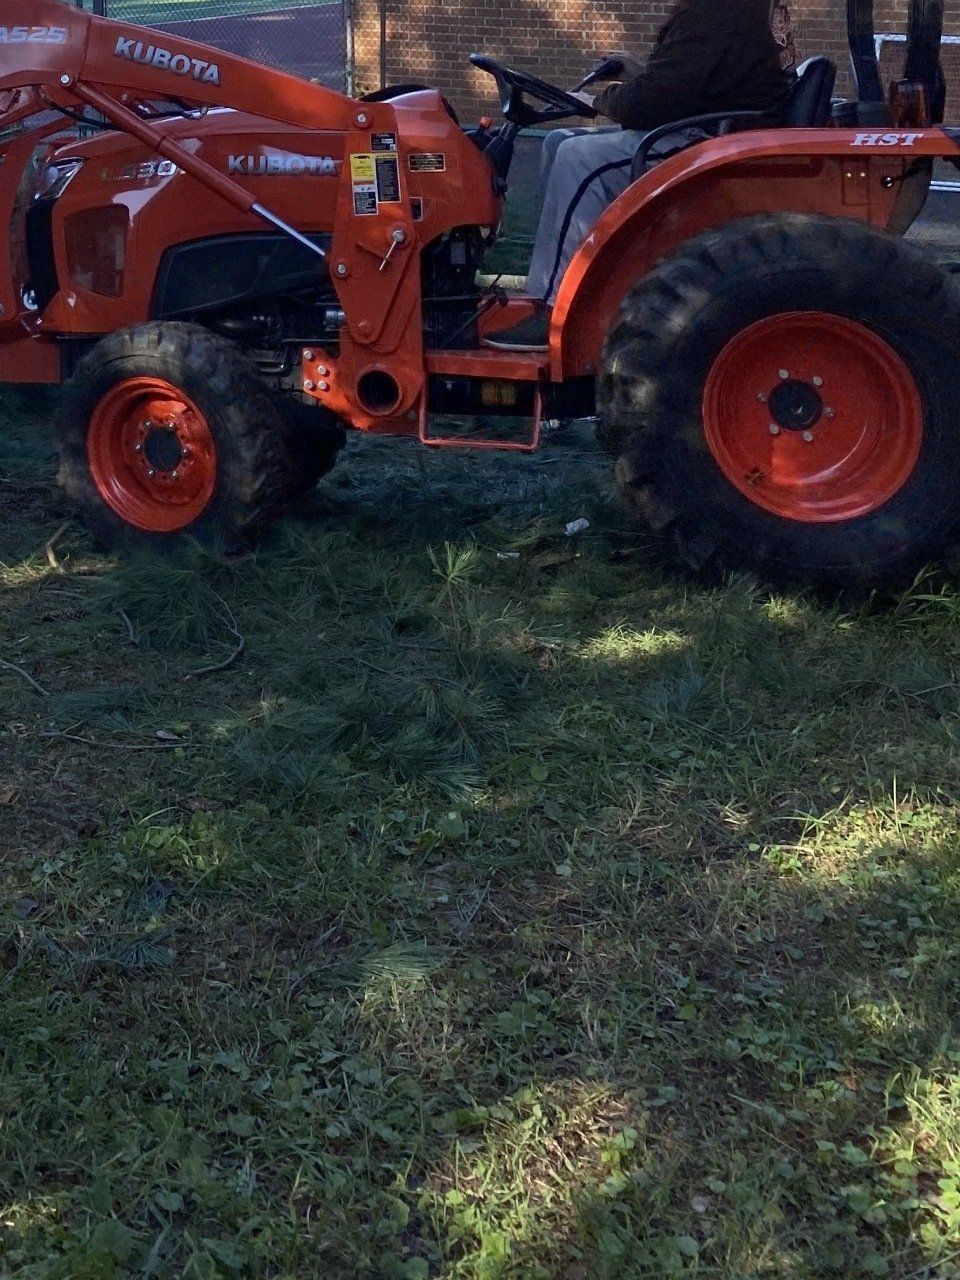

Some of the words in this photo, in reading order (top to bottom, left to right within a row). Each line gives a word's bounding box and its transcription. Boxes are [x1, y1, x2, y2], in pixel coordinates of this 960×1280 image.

[114, 35, 221, 86] KUBOTA
[849, 133, 924, 146] HST
[227, 154, 339, 176] KUBOTA
